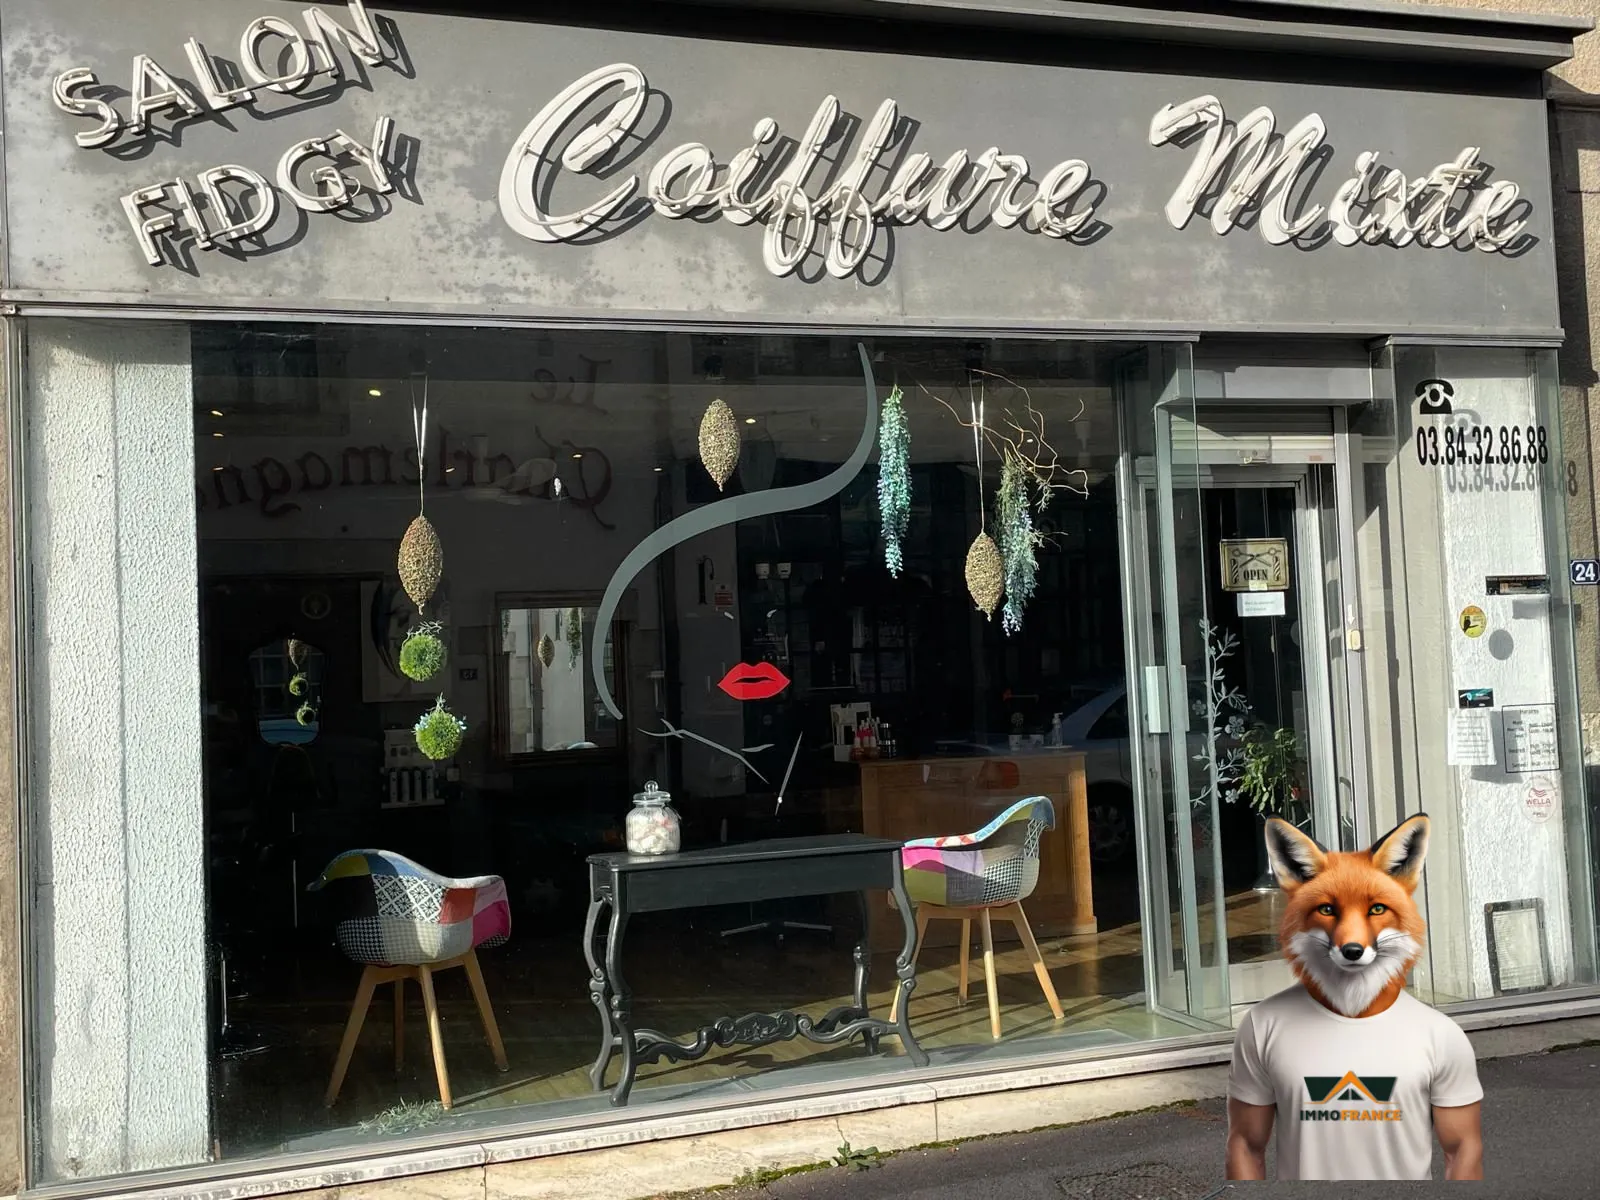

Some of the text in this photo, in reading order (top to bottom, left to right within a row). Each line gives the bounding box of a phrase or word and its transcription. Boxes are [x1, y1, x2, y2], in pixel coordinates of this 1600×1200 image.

[52, 0, 385, 148] SALON
[120, 115, 393, 267] FIDGY
[498, 63, 1527, 278] Coiffure Mixte
[1416, 425, 1549, 466] 03.84.32.86.88
[1243, 569, 1269, 581] OPEN
[1575, 563, 1596, 582] 24
